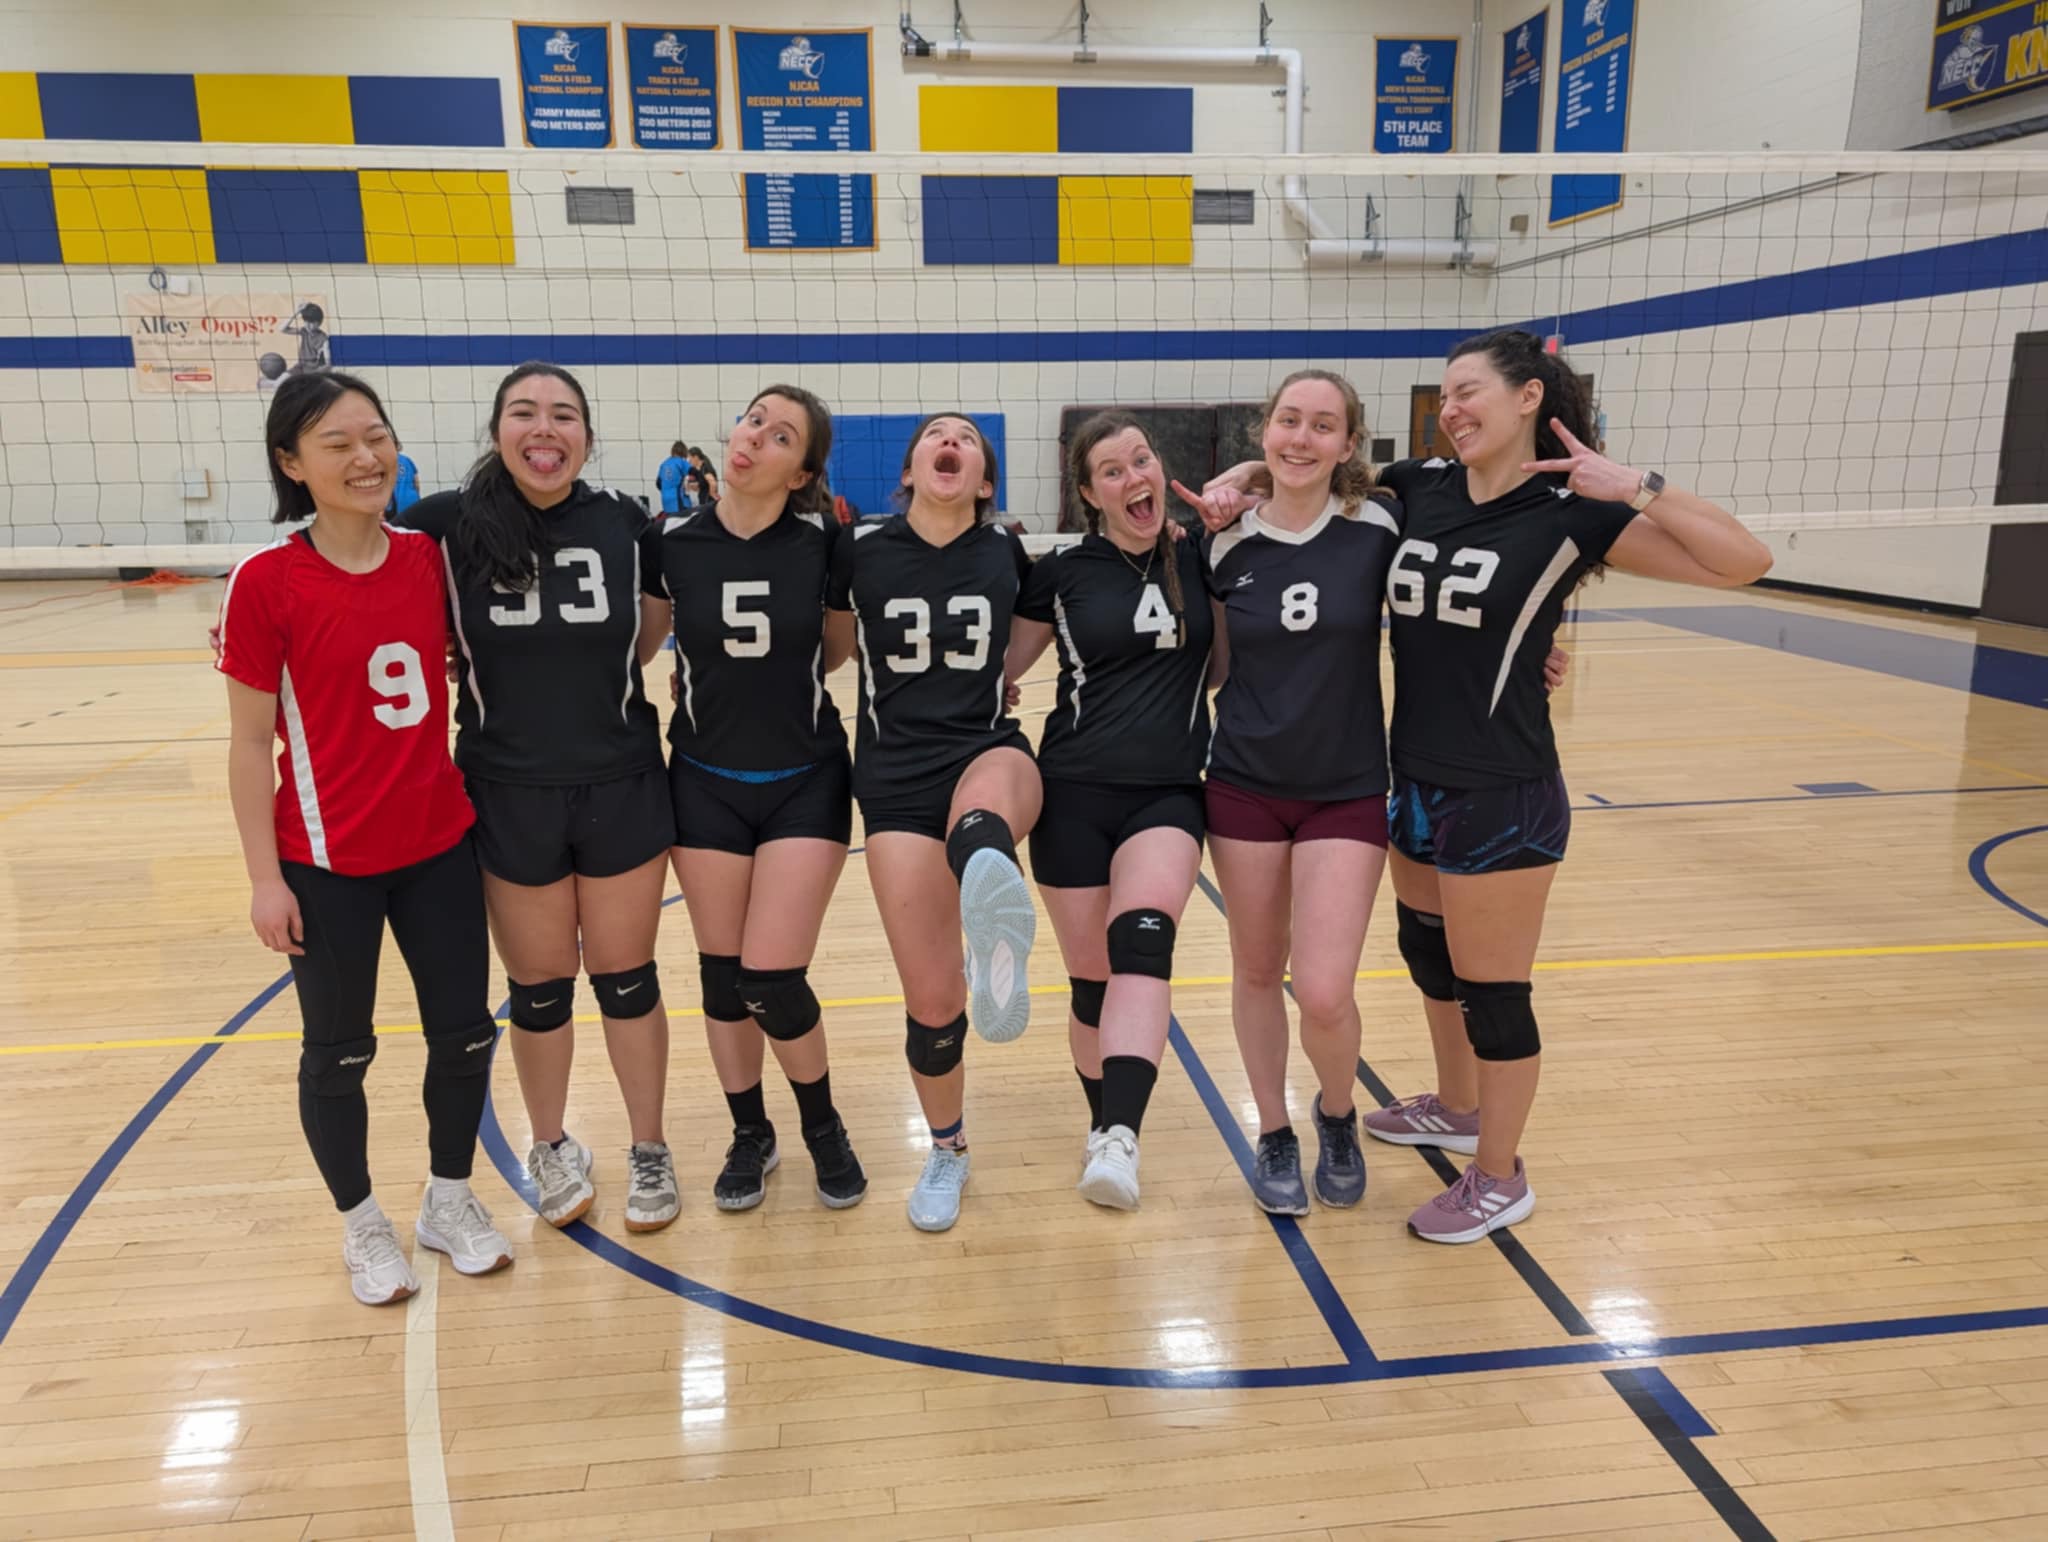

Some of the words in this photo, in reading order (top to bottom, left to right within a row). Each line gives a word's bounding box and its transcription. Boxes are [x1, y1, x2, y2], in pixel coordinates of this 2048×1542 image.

[780, 56, 814, 69] NECC
[1942, 55, 1984, 84] NECC
[789, 80, 820, 91] NJCAA
[747, 96, 783, 107] REGION
[804, 96, 863, 107] CHAMPIONS
[534, 107, 563, 117] JIMMY
[530, 120, 548, 130] 400
[549, 121, 583, 130] METERS
[657, 118, 690, 128] METERS
[1384, 120, 1406, 133] 5TH
[1408, 120, 1442, 133] PLACE
[657, 130, 690, 140] METERS
[1397, 134, 1429, 147] TEAM
[137, 316, 190, 338] Alley
[201, 316, 278, 338] Oops!?
[1386, 538, 1501, 628] 62
[1281, 581, 1319, 632] 8
[722, 580, 771, 658] 5
[1133, 583, 1177, 648] 4
[884, 595, 992, 673] 33
[368, 641, 430, 730] 9
